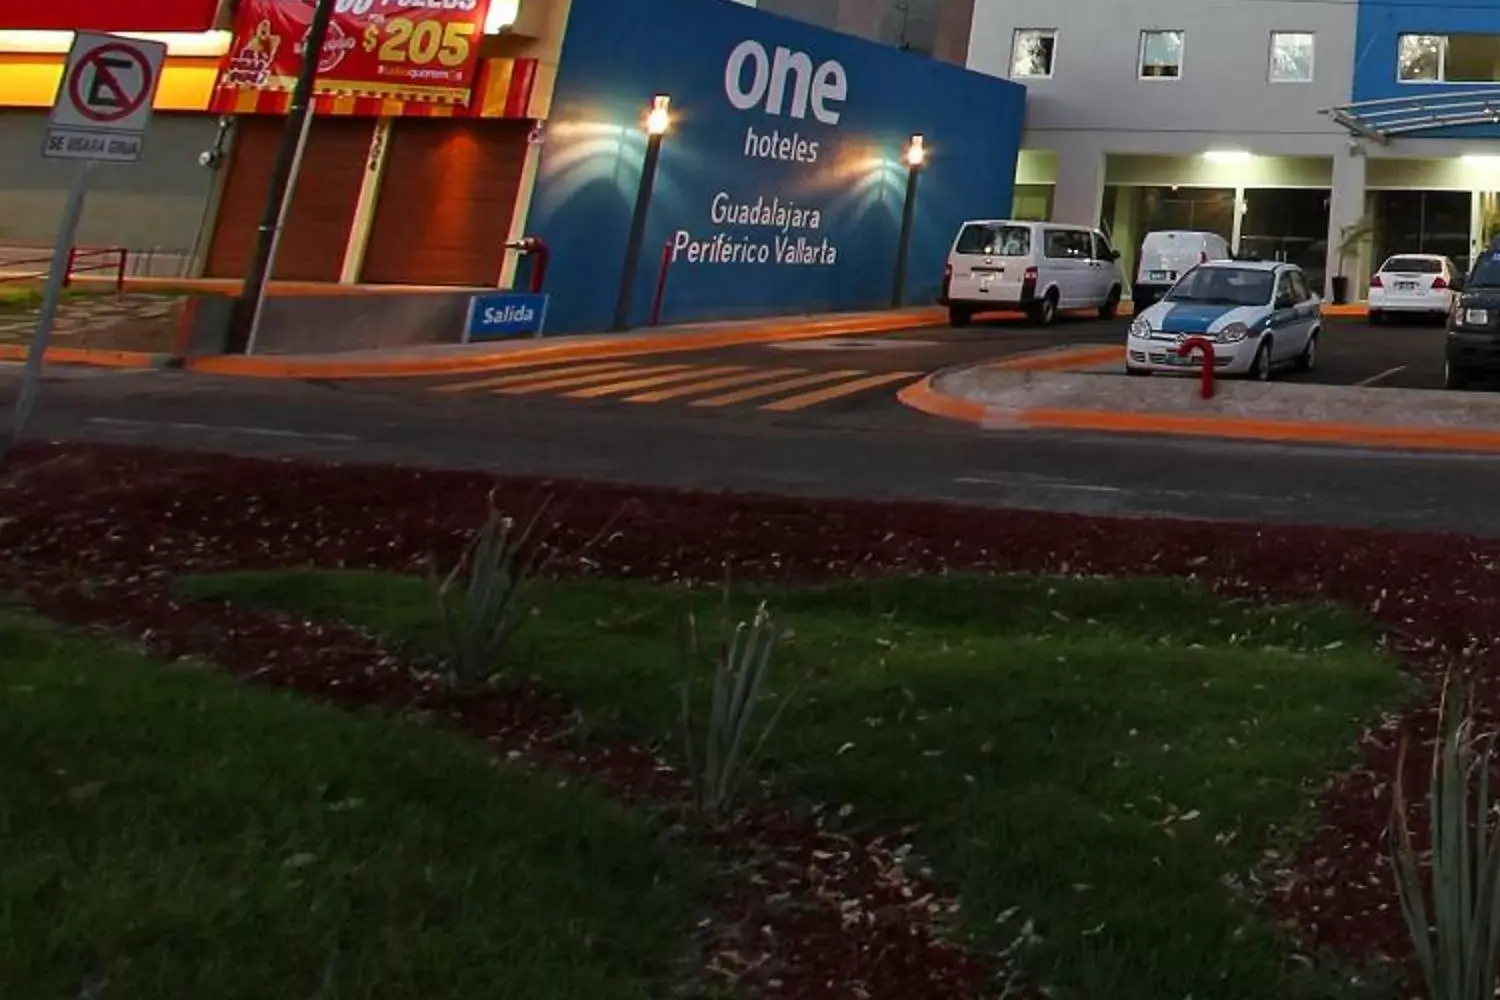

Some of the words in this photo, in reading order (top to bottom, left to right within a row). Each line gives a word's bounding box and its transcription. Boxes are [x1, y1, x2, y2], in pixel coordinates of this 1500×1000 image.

[725, 39, 847, 125] one
[744, 126, 819, 163] hoteles
[711, 192, 821, 233] Guadalajara
[671, 230, 769, 263] Periférico
[775, 236, 837, 265] Vallarta
[482, 304, 534, 324] Salida
